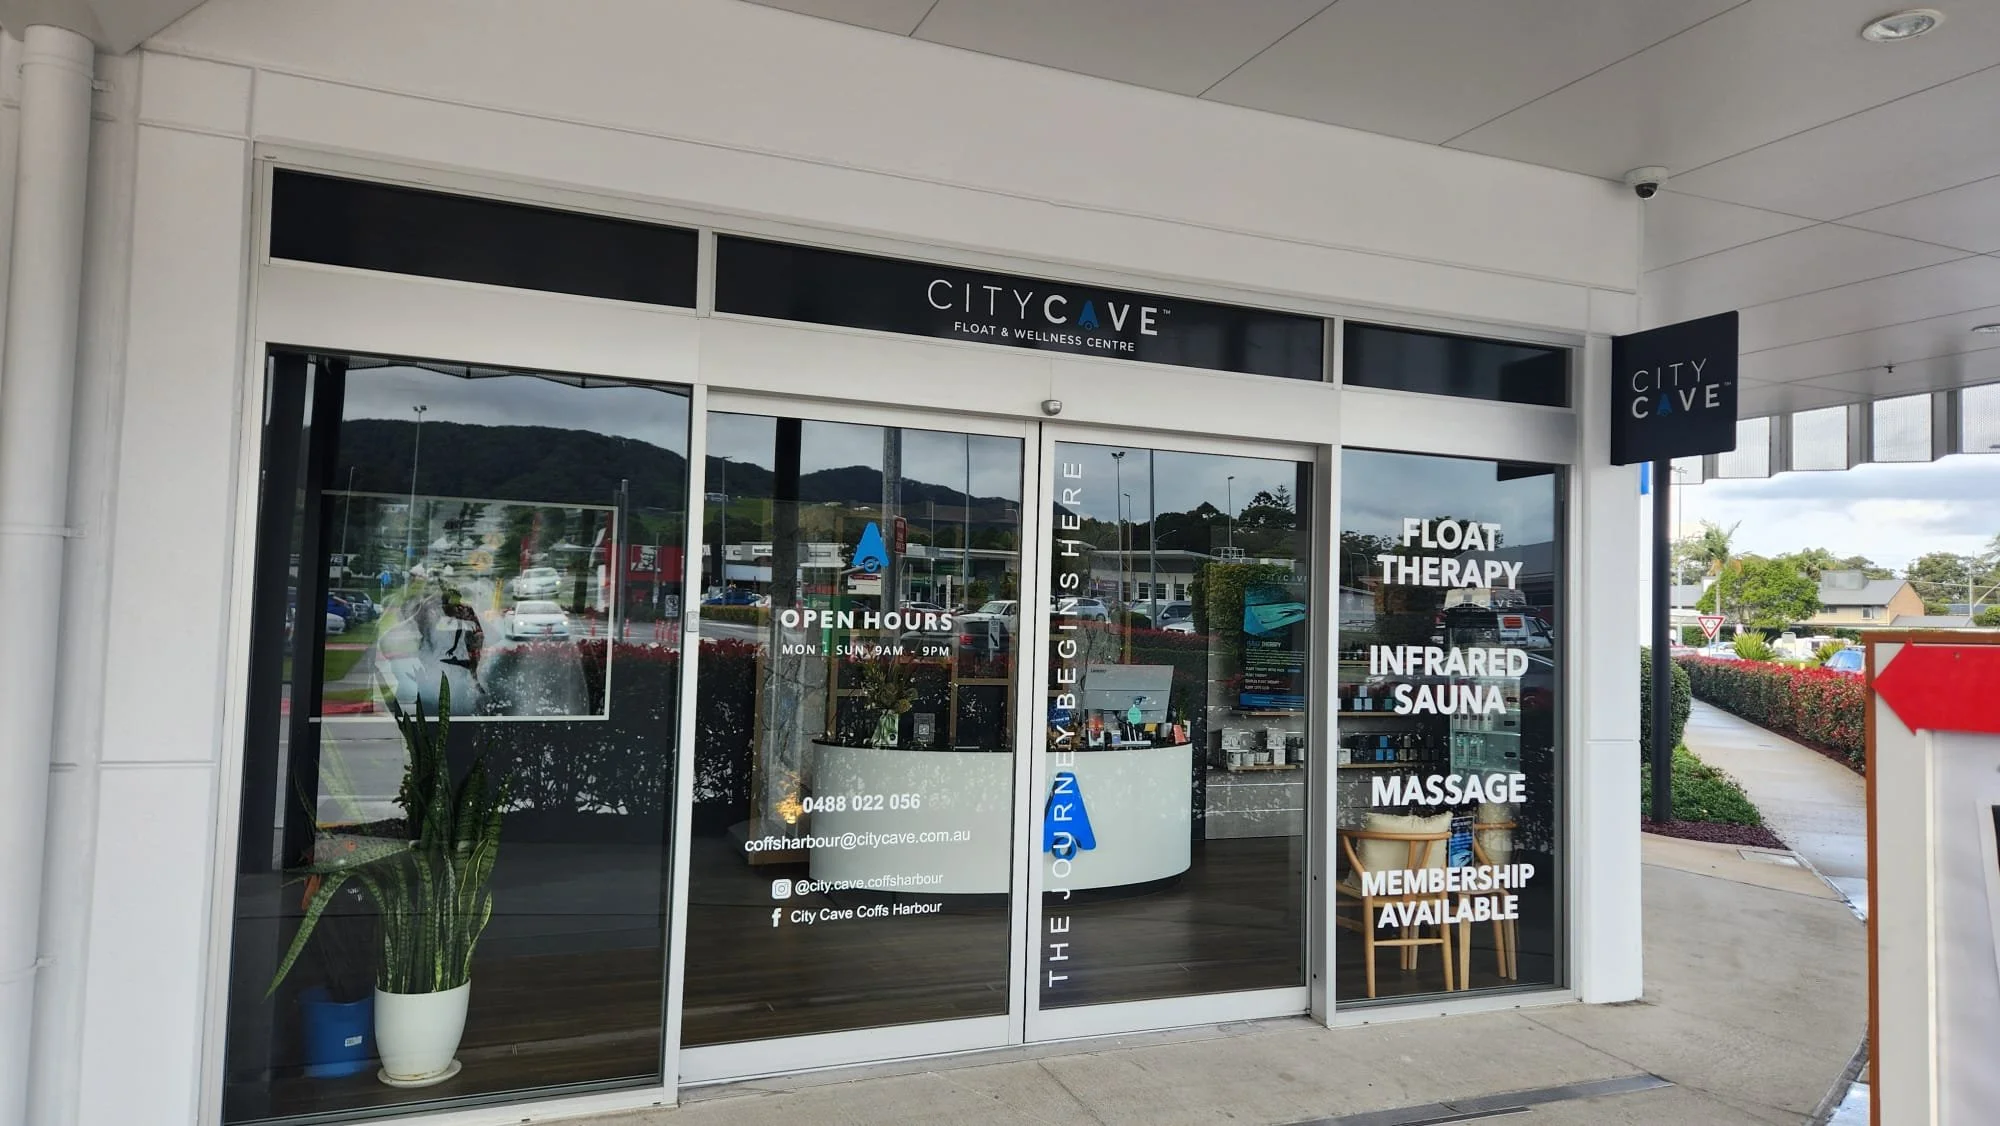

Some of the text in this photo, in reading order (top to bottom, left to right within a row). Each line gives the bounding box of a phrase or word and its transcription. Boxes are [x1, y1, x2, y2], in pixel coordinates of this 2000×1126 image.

[954, 321, 1136, 352] FLOAT & WELLNESS CENTRE
[1632, 358, 1707, 393] CITY
[1402, 517, 1502, 552] FLOAT
[1377, 554, 1523, 590] THERAPY
[780, 609, 952, 632] OPEN HOURS
[782, 644, 815, 655] MON
[836, 645, 863, 656] SUN
[875, 645, 903, 656] 9AM
[922, 646, 949, 657] 9PM
[1369, 645, 1529, 678] INFRARED
[1393, 683, 1507, 715] SAUNA
[1048, 462, 1082, 988] THE JOURNEY BEGINS HERE
[802, 793, 921, 814] 0488 022 056
[1371, 773, 1527, 807] MASSAGE
[744, 829, 971, 852] coffsharbour@citycave.com.au
[794, 872, 943, 895] @city.cave.coffsharbour
[1361, 863, 1535, 897] MEMBERSHIP
[790, 909, 816, 925] City
[819, 908, 853, 922] Cave
[856, 904, 889, 918] Coffs
[893, 901, 942, 916] Harbour
[1377, 895, 1520, 928] AVAILABLE
